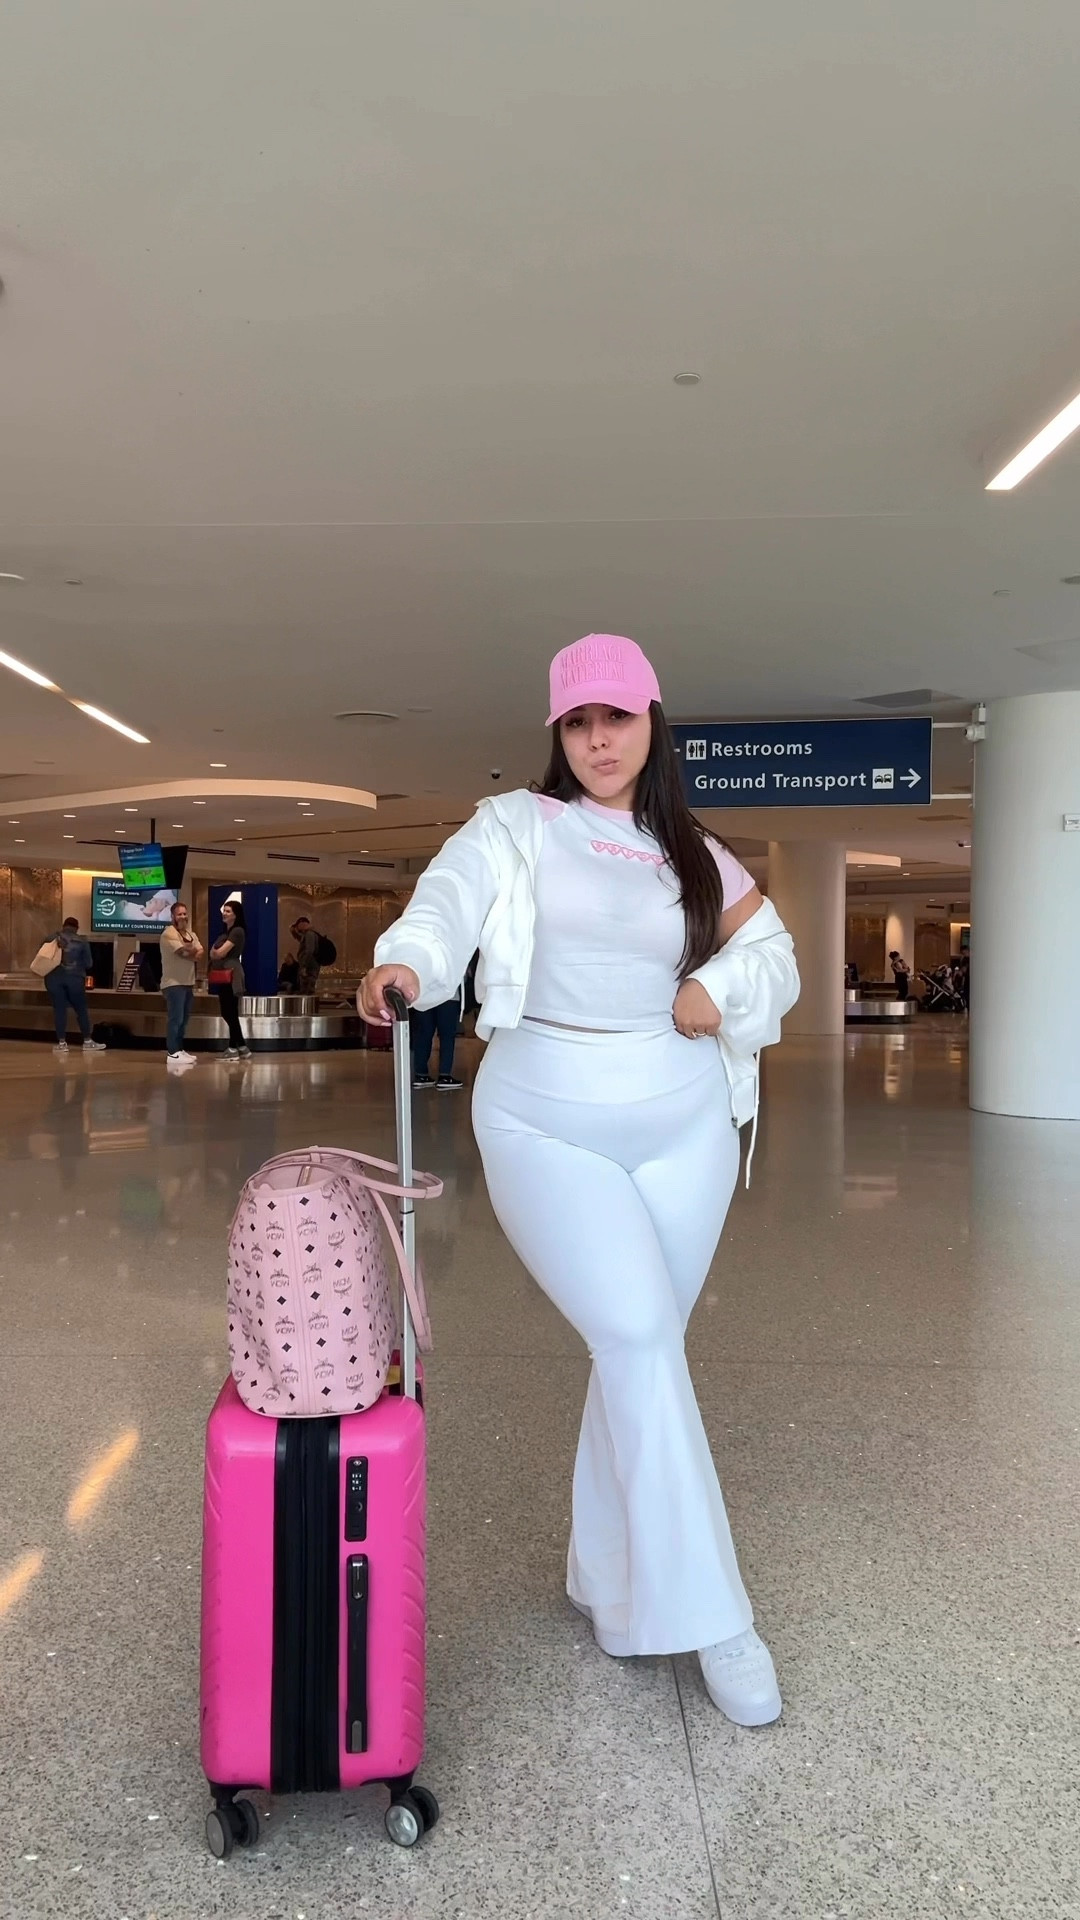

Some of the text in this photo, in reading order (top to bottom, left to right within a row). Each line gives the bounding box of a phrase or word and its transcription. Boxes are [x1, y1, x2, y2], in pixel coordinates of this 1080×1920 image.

[711, 741, 813, 757] Restrooms
[694, 771, 867, 791] Ground Transport
